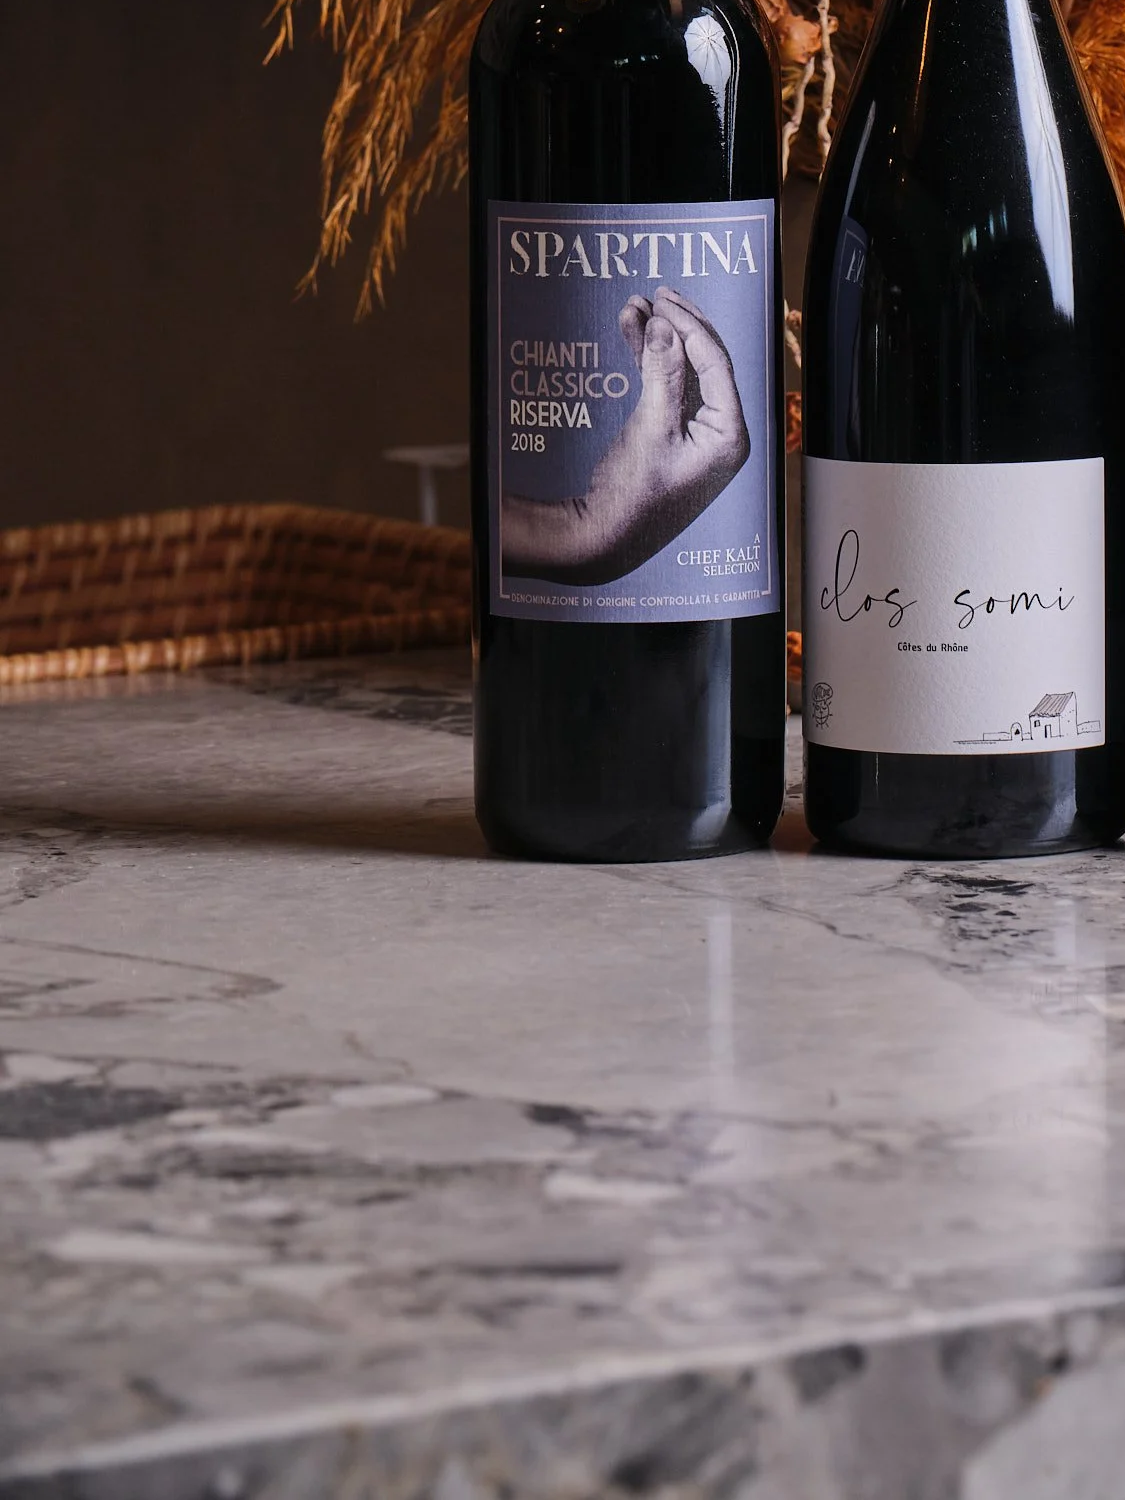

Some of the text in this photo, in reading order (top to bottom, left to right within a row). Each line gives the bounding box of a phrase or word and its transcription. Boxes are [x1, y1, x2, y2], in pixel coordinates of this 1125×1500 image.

[510, 229, 759, 279] SPARTINA
[510, 340, 599, 369] CHIANTI
[510, 370, 629, 399] CLASSICO
[510, 399, 592, 430] RISERVA
[511, 433, 546, 453] 2018
[753, 532, 761, 544] A
[676, 545, 761, 566] CHEF KALT
[703, 561, 760, 577] SELECTION
[820, 529, 1075, 630] clos somi
[511, 589, 761, 607] DENOMINAZIONE DI ORIGINE CONTROLLATA E GARANTITA
[897, 642, 969, 653] Côtes du Rhône
